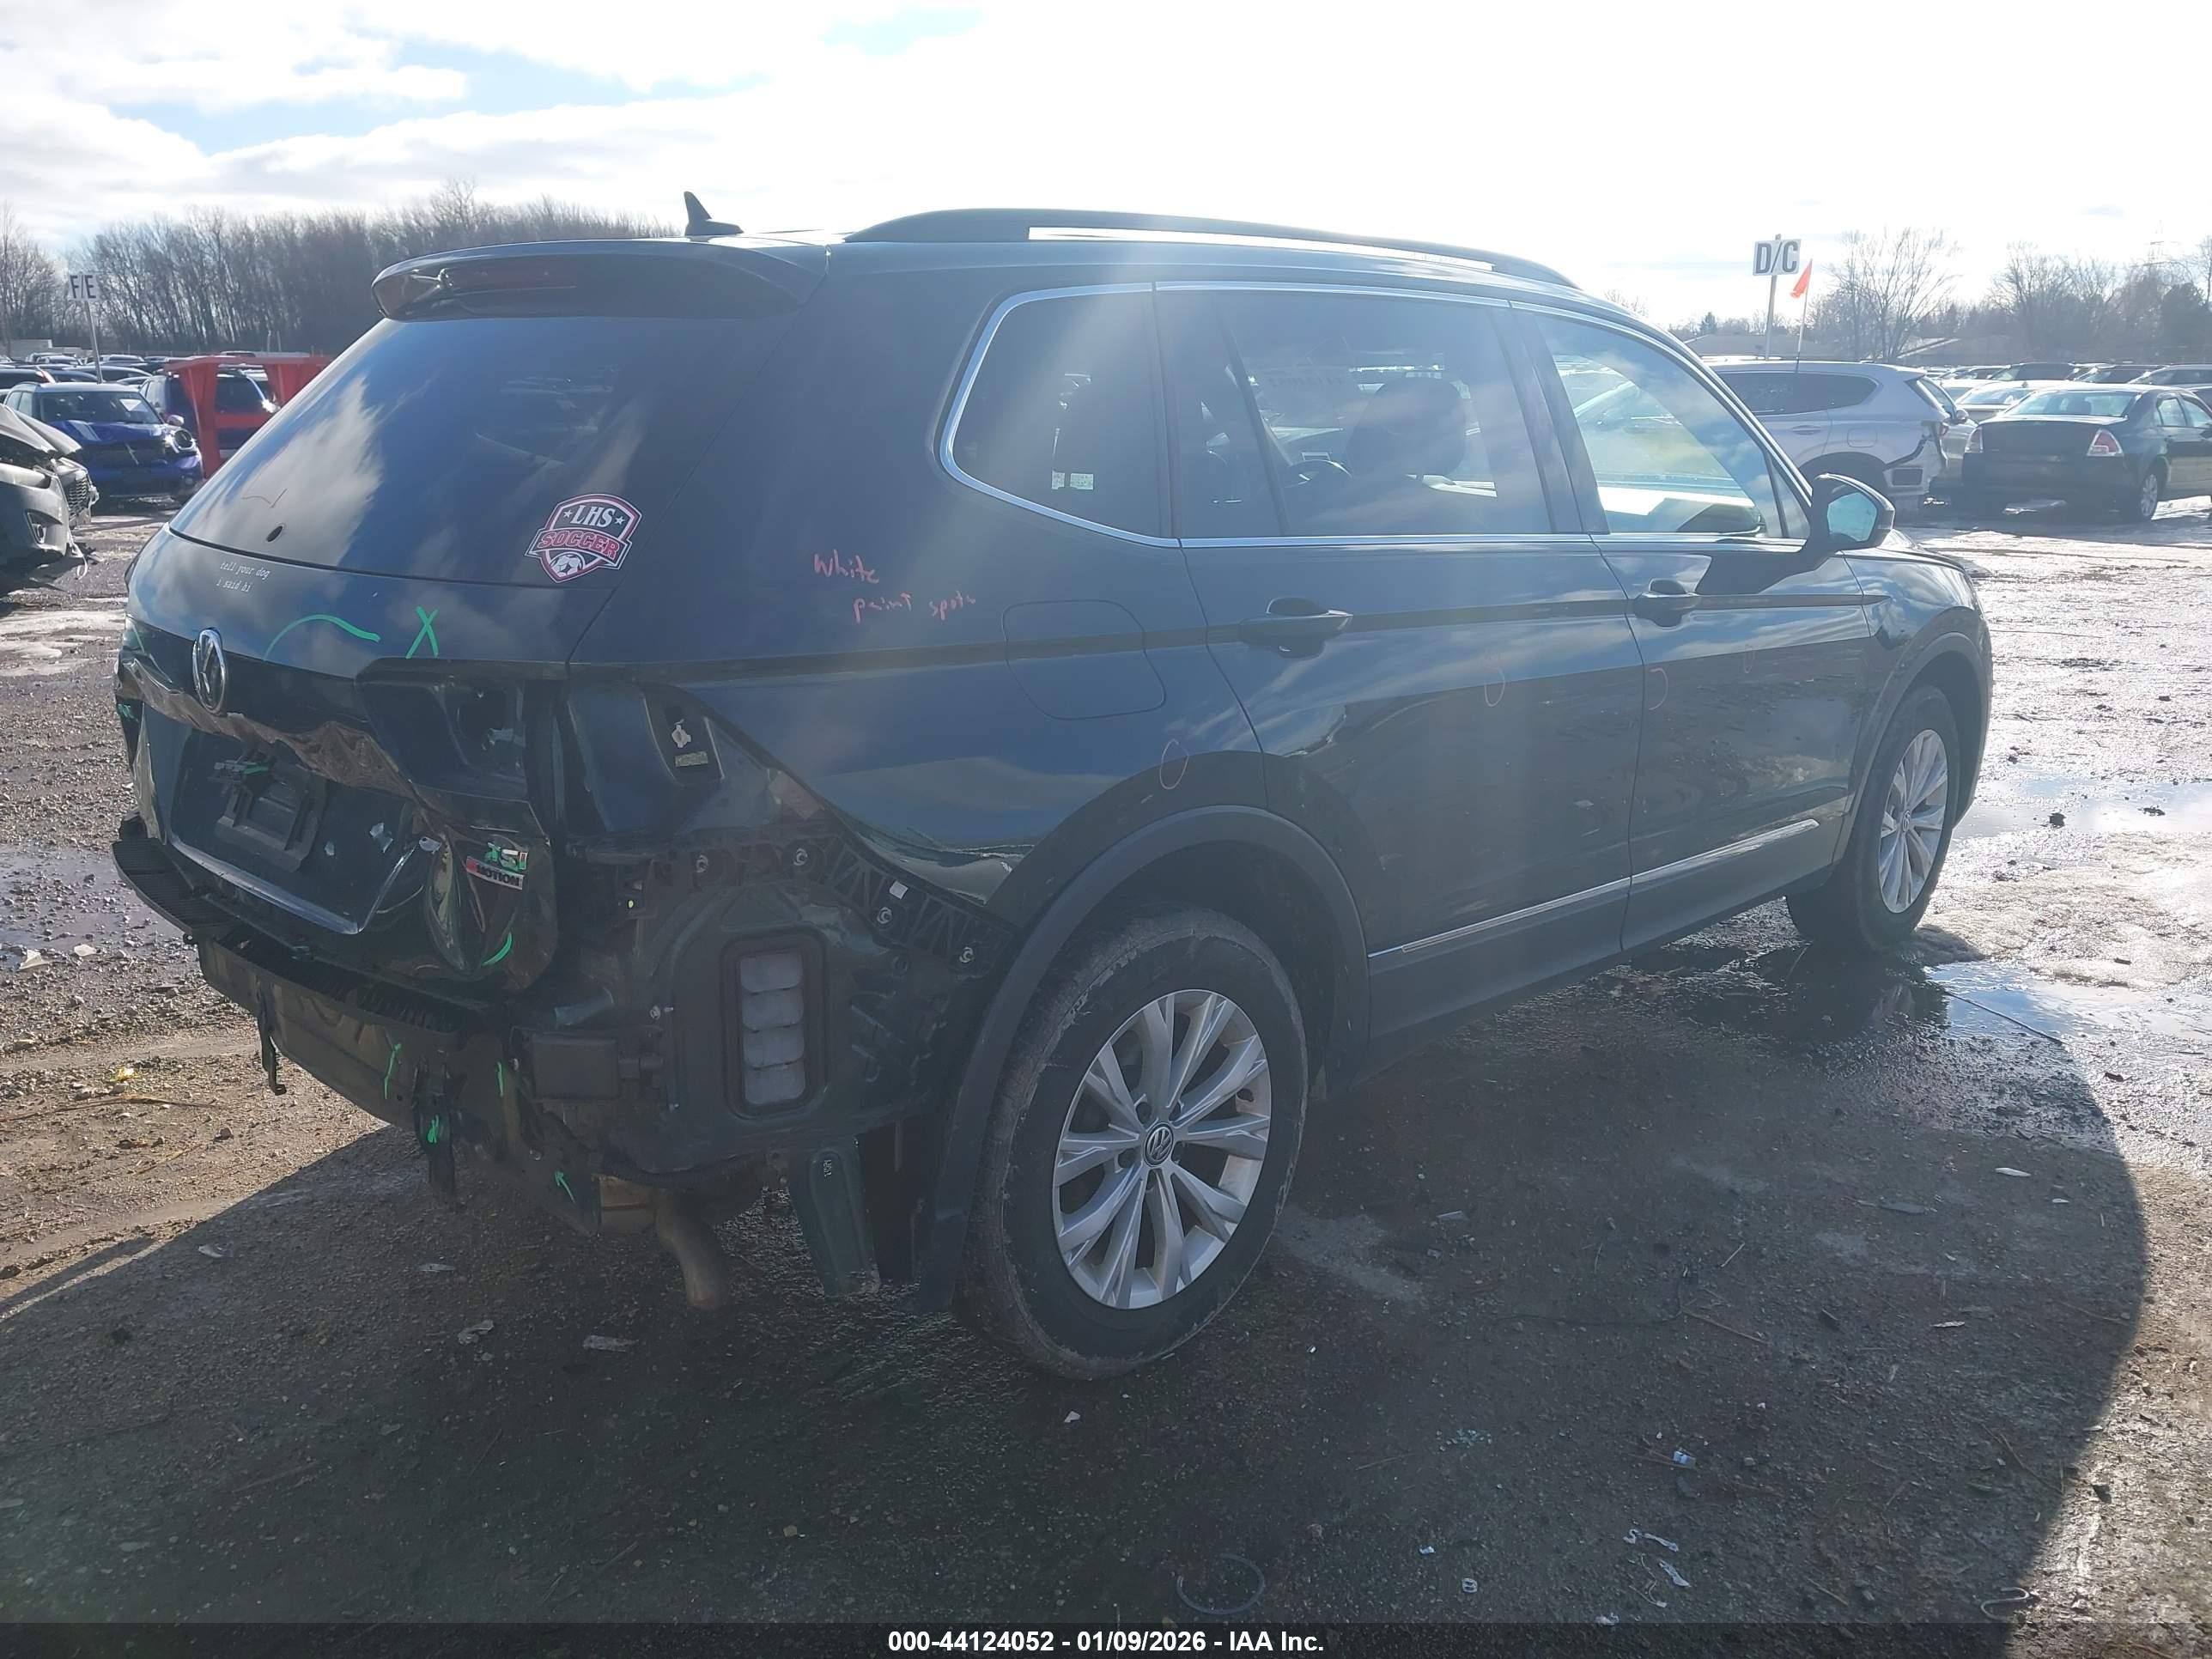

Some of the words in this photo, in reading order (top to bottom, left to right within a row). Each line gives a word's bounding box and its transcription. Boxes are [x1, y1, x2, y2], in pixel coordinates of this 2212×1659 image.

[1755, 240, 1799, 274] D/C
[70, 274, 97, 299] F/E
[570, 504, 616, 528] LHS
[537, 531, 620, 561] SOCCER
[220, 561, 237, 571] tell
[235, 565, 255, 575] your
[255, 567, 270, 580] dog
[222, 580, 242, 590] said
[241, 581, 252, 592] hi
